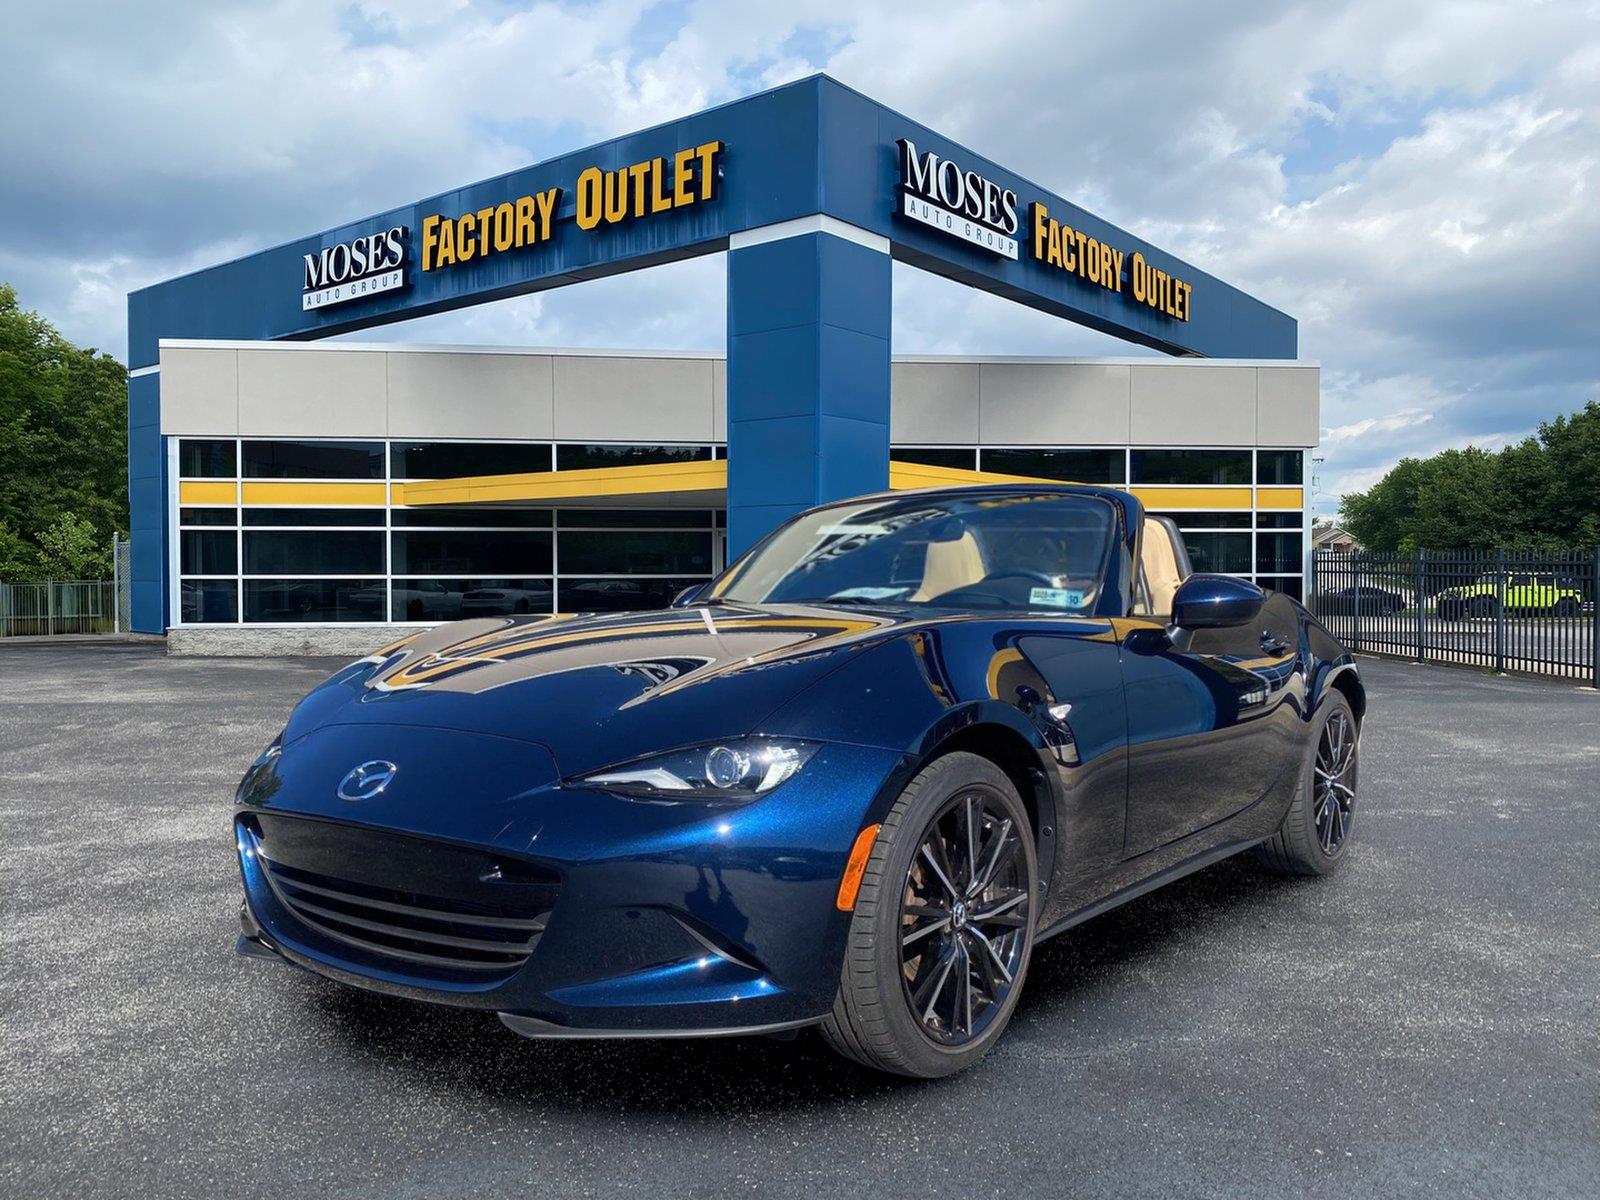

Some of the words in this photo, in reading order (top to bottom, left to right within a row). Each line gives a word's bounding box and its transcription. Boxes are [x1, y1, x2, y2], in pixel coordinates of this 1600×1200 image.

[422, 188, 559, 272] FACTORY
[576, 140, 719, 231] OUTLET
[904, 138, 1018, 235] MOSES
[910, 200, 952, 228] AUTO
[965, 223, 1014, 253] GROUP
[303, 227, 403, 290] MOSES
[306, 288, 340, 307] AUTO
[351, 273, 399, 295] GROUP
[1034, 201, 1124, 293] FACTORY
[1132, 251, 1192, 322] OUTLET
